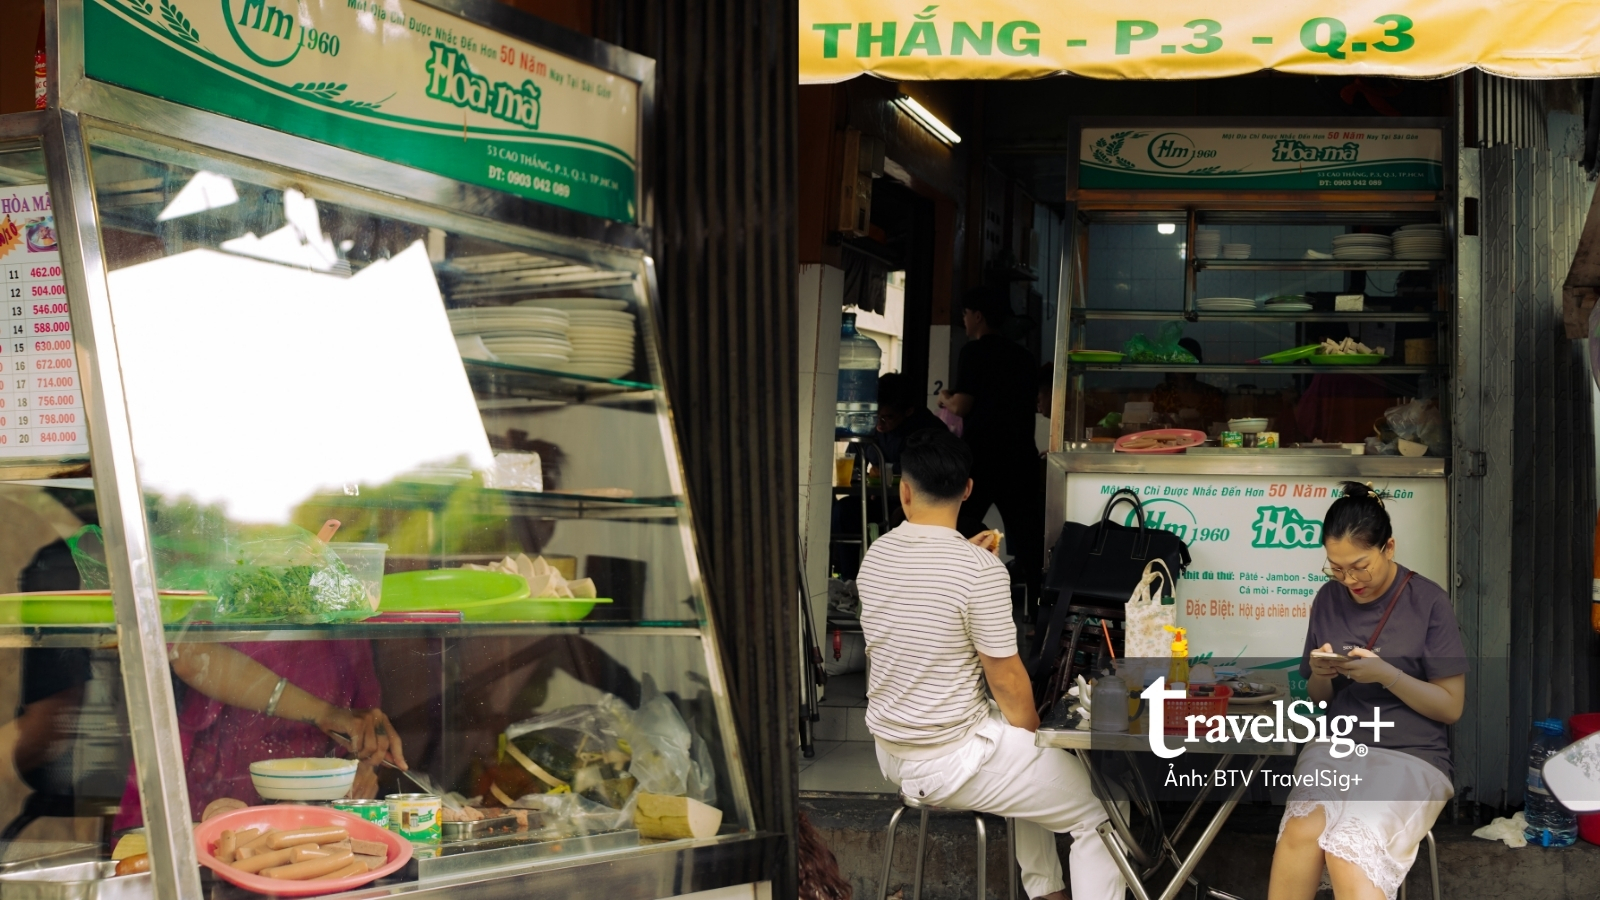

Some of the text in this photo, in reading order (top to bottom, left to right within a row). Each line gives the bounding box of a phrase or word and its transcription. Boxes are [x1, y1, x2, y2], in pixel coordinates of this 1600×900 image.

[811, 5, 1041, 57] THẮNG
[1114, 19, 1224, 56] P.3
[1299, 14, 1416, 60] Q.3
[296, 25, 340, 57] 1960
[408, 16, 432, 36] Được
[435, 26, 457, 43] Nhắc
[461, 35, 479, 52] Đến
[500, 45, 516, 66] 50
[519, 51, 547, 78] Năm
[1327, 131, 1340, 140] 50
[1342, 131, 1365, 140] Năm
[486, 144, 498, 156] 53
[498, 147, 518, 162] CAO
[1156, 139, 1217, 159] Hm 1960
[488, 164, 506, 182] ĐT:
[507, 170, 532, 188] 0903
[533, 176, 551, 193] 042
[1, 193, 31, 214] HÒA
[9, 270, 19, 280] 11
[10, 288, 21, 298] 12
[12, 303, 69, 316] 13 546.000
[13, 321, 70, 334] 14 588.000
[14, 343, 25, 353] 15
[35, 339, 71, 351] 630.000
[15, 361, 26, 371] 16
[36, 358, 72, 370] 672.000
[16, 379, 26, 389] 17
[37, 376, 73, 388] 714.000
[17, 397, 28, 407] 18
[38, 395, 74, 406] 756.000
[18, 416, 29, 425] 19
[39, 413, 76, 425] 798.000
[19, 434, 30, 444] 20
[40, 431, 77, 443] 840.000
[1143, 485, 1160, 495] Chỉ
[1163, 486, 1189, 497] Được
[1192, 484, 1218, 496] Nhắc
[1221, 485, 1241, 496] Đến
[1244, 487, 1265, 497] Hơn
[1268, 483, 1288, 497] 50
[1292, 483, 1328, 498] Năm
[1330, 488, 1345, 498] Na
[1393, 488, 1414, 499] Gòn
[1190, 527, 1230, 542] 1960
[1202, 570, 1214, 580] đủ
[1239, 572, 1259, 581] Pâté
[1265, 572, 1300, 582] Jambon
[1307, 573, 1330, 582] Sauc
[1239, 585, 1251, 595] Cá
[1252, 586, 1269, 595] mòi
[1277, 586, 1314, 597] Formage
[1186, 599, 1207, 620] Đặc
[1209, 599, 1235, 620] Biệt:
[1239, 604, 1254, 620] Hột
[1255, 605, 1265, 621] gà
[1267, 603, 1290, 618] chiên
[1291, 602, 1307, 618] chả
